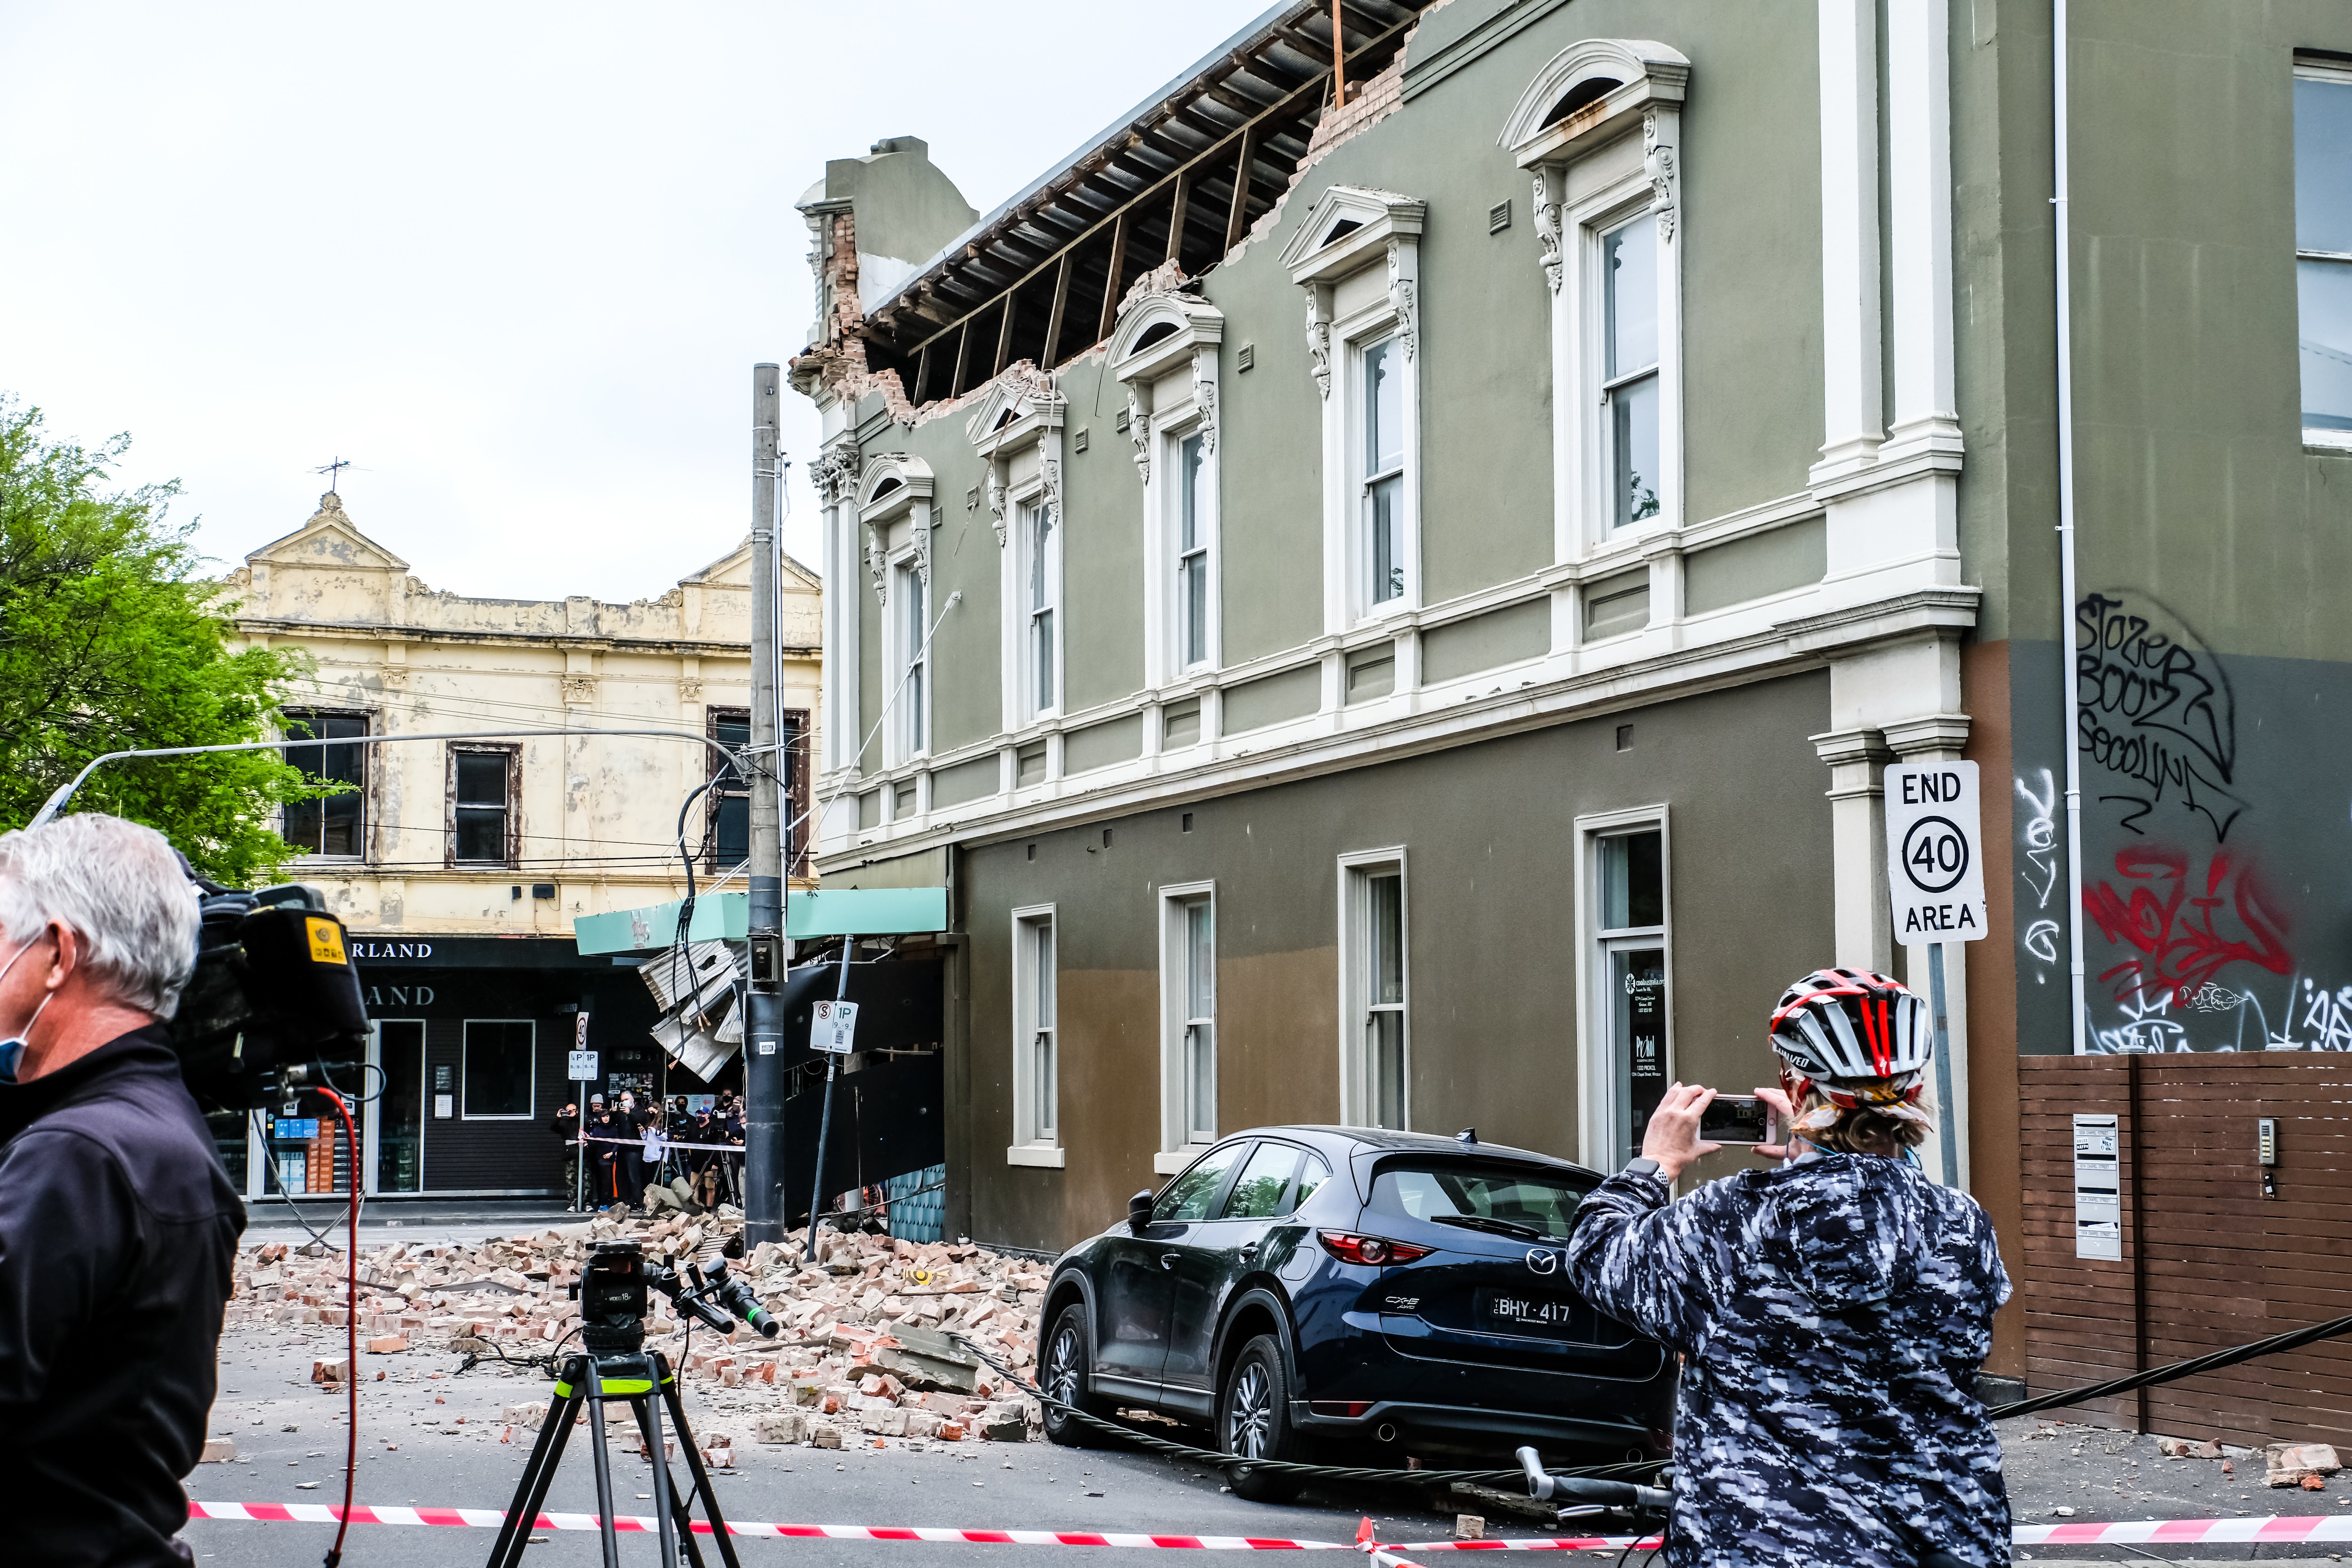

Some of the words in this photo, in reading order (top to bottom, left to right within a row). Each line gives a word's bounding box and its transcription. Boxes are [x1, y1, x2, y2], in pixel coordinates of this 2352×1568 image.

[1902, 772, 1961, 804] END
[1912, 834, 1960, 874] 40
[1906, 903, 1976, 932] AREA
[351, 943, 432, 958] RLAND
[365, 986, 435, 1005] AND
[839, 1007, 851, 1019] 1P
[578, 1024, 585, 1038] 40
[1385, 1296, 1420, 1305] CX-5
